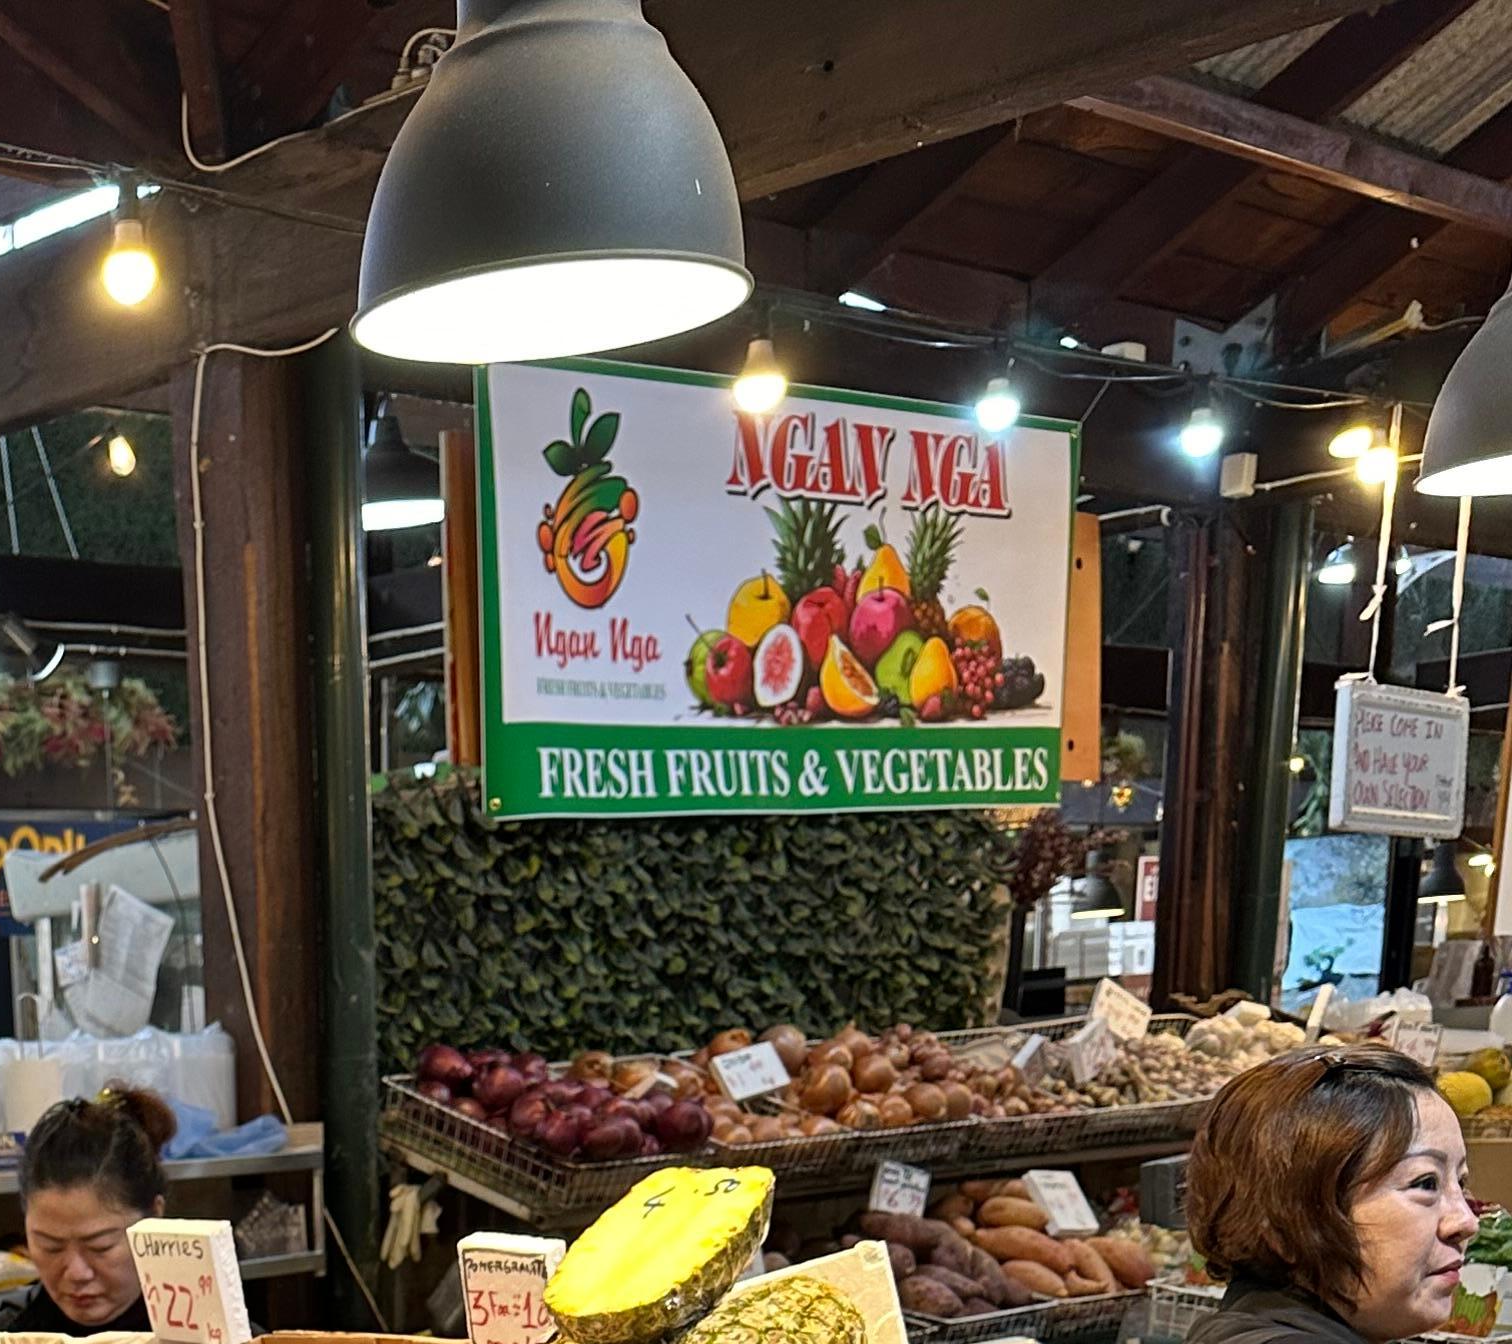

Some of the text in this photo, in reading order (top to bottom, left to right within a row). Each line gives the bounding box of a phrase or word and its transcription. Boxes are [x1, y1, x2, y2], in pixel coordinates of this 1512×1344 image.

[726, 408, 1011, 518] NGAN NGA
[534, 611, 662, 673] Ngan Nga
[1425, 719, 1444, 740] IN
[537, 746, 1048, 799] FRESH FRUITS & VEGETABLES
[467, 1290, 489, 1327] 3
